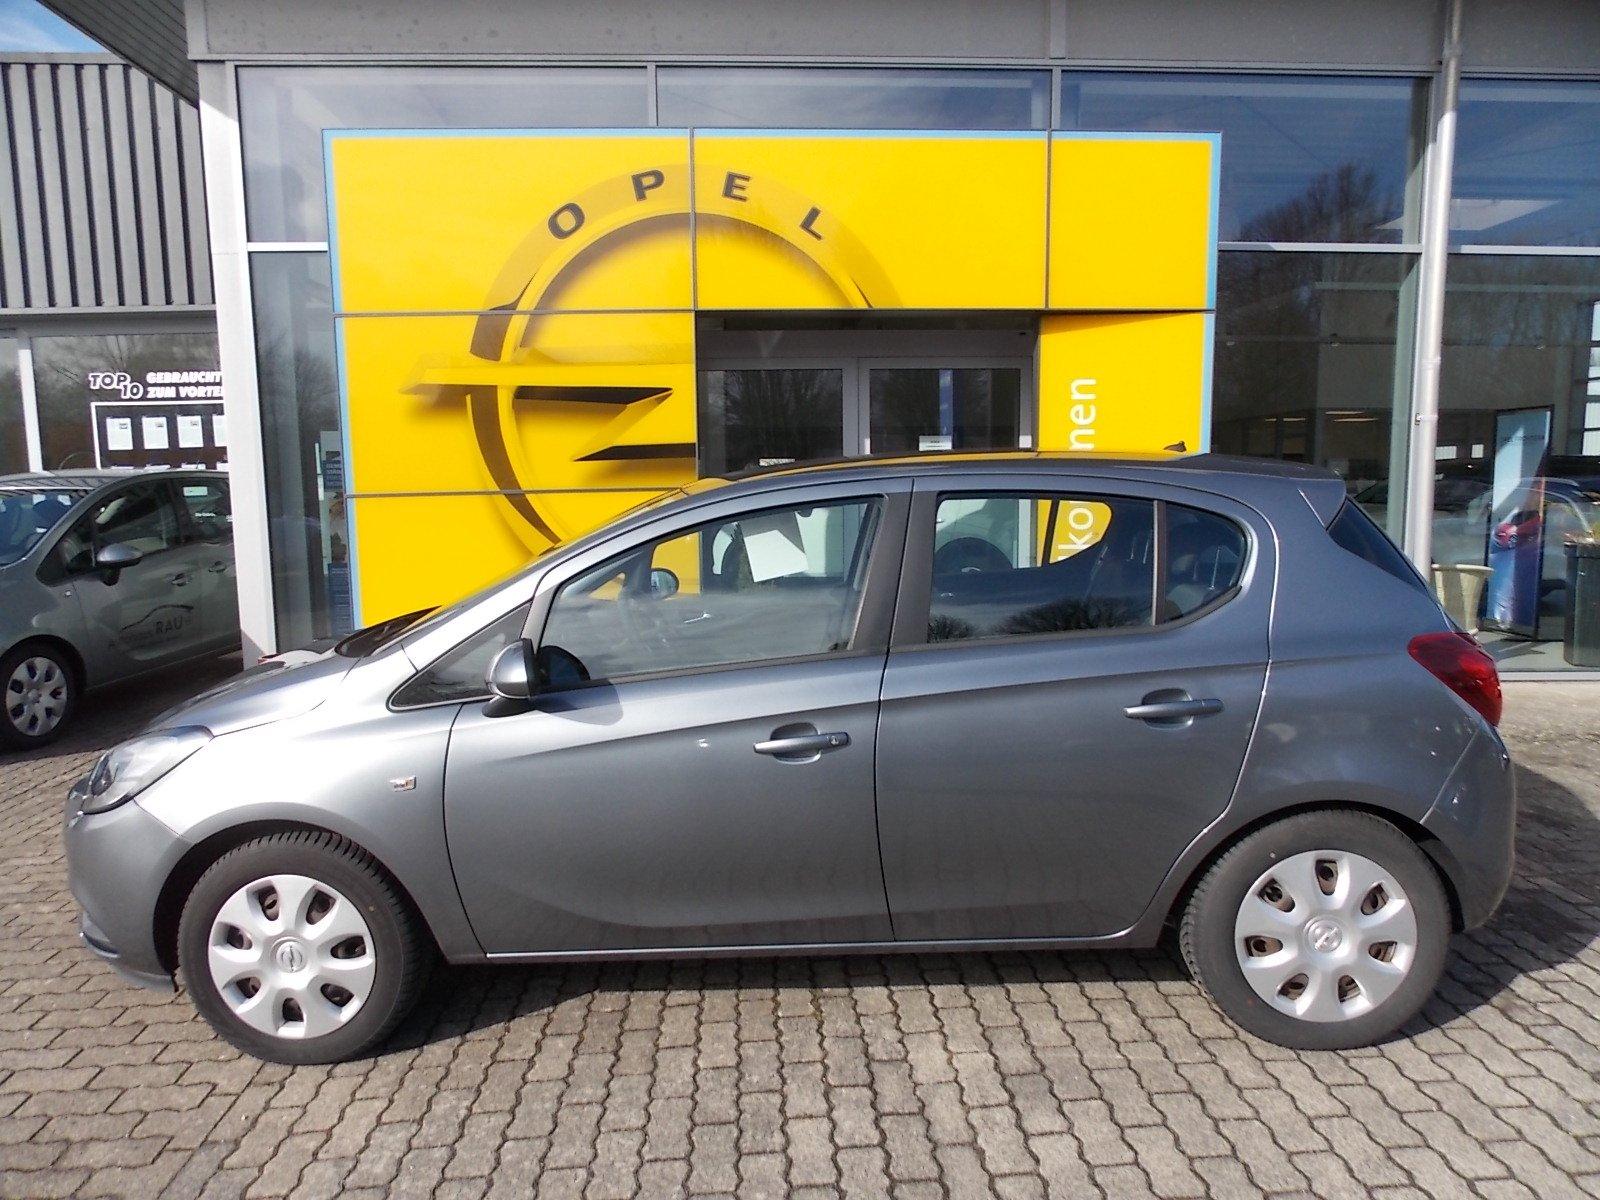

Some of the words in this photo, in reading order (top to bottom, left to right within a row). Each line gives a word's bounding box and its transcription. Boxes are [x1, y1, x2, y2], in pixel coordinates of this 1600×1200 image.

[548, 169, 824, 241] OPEL
[89, 372, 130, 389] TOP
[120, 382, 144, 399] 10
[146, 386, 176, 398] ZUM
[155, 615, 183, 633] RAU
